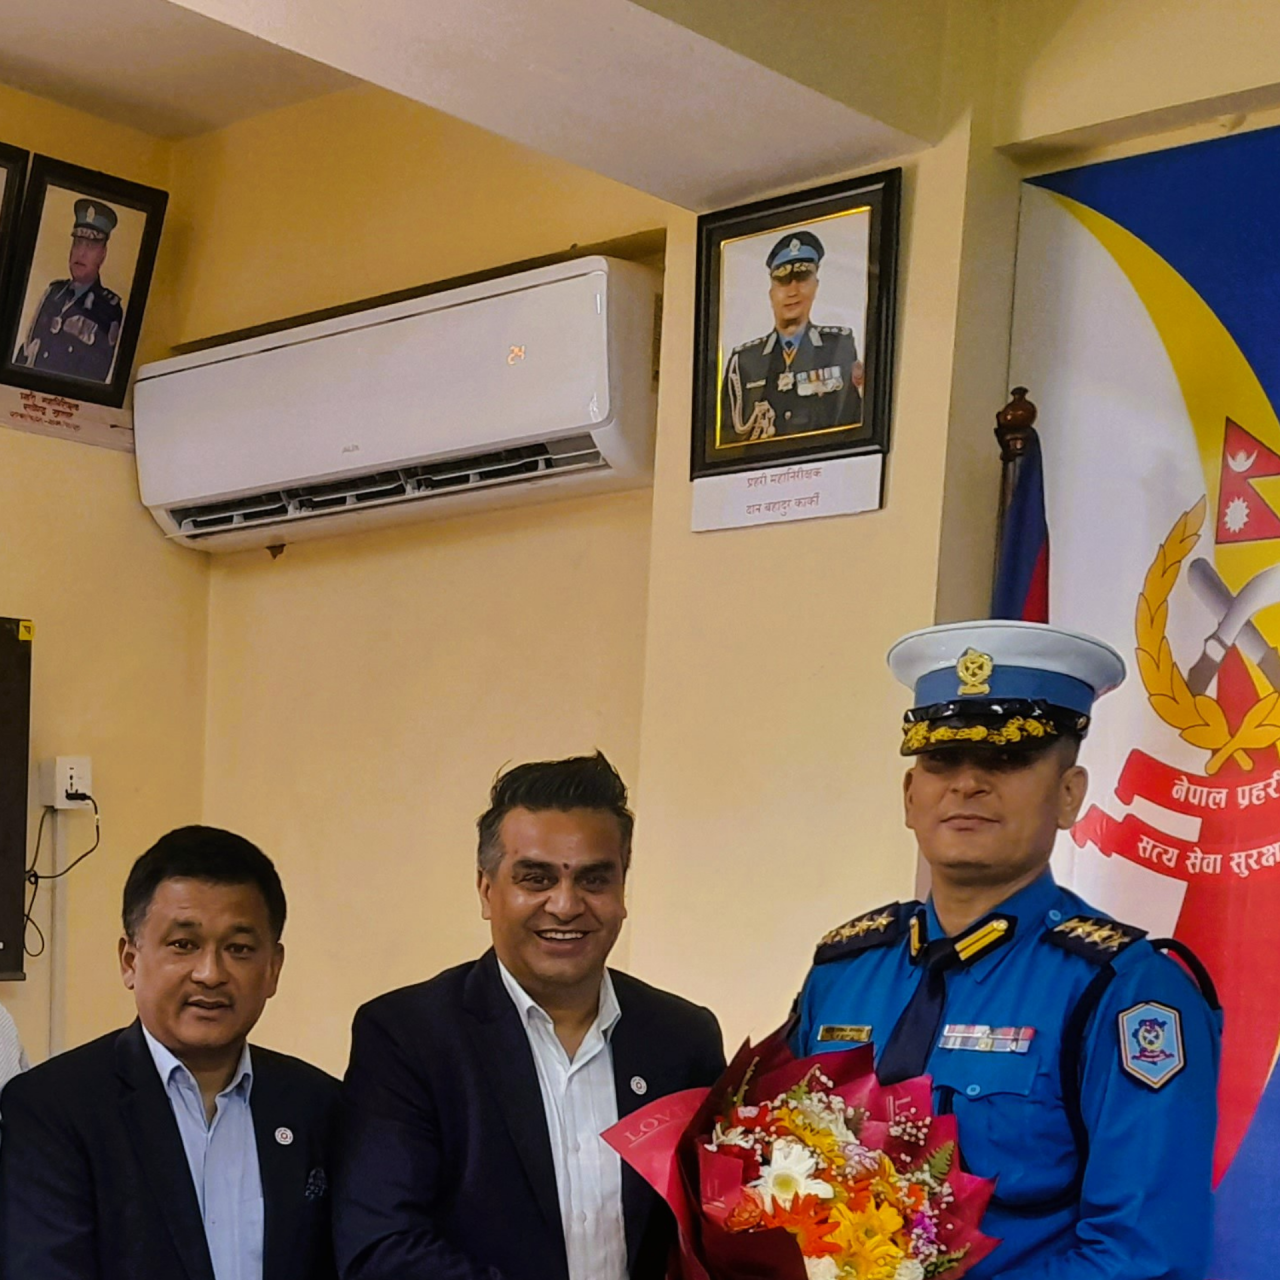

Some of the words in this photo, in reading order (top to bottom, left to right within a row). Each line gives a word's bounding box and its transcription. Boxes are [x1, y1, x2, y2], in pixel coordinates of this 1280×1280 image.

[508, 345, 525, 365] 24
[746, 472, 767, 488] प्रहरी
[770, 467, 823, 486] महानिरीक्षक
[746, 503, 761, 516] दान
[1172, 775, 1229, 809] नेपाल
[1137, 834, 1180, 868] सत्य
[1185, 846, 1222, 874] सेवा
